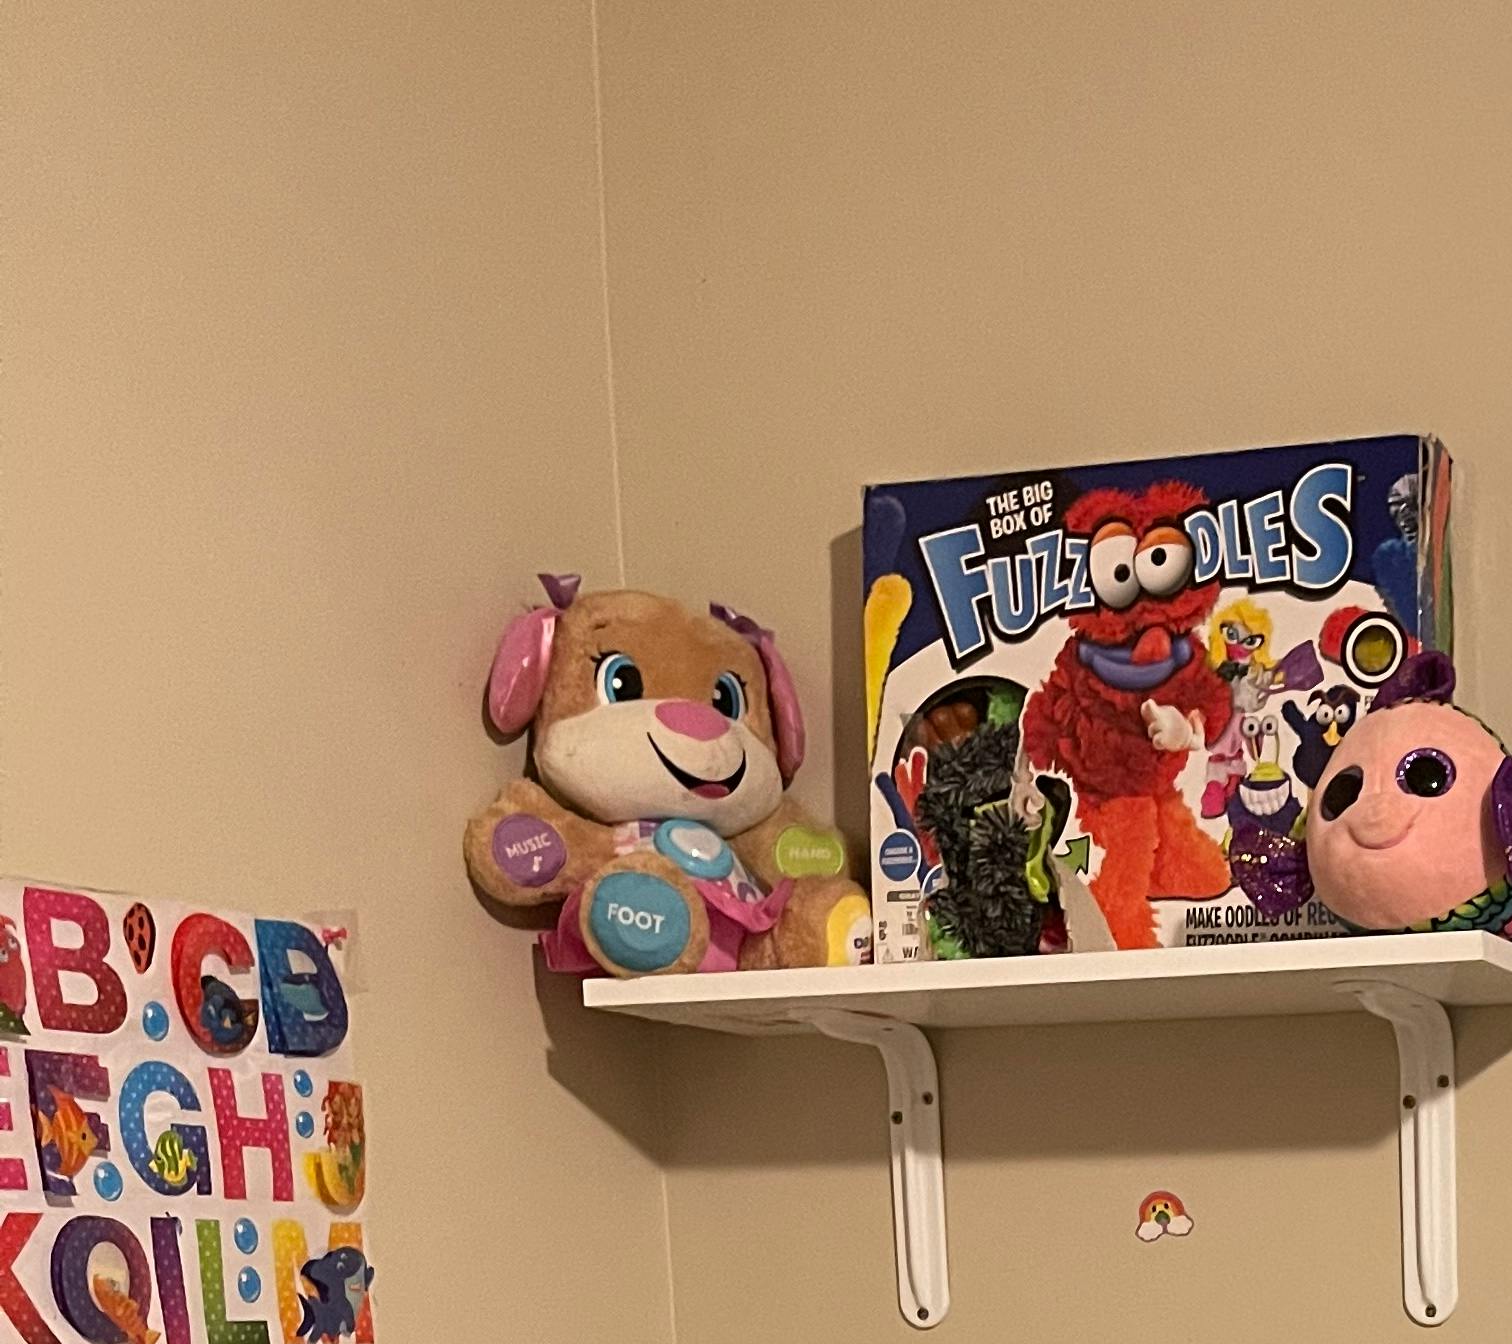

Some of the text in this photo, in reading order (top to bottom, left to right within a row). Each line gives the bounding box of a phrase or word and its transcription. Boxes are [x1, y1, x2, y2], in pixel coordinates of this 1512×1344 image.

[985, 480, 1054, 516] THE BIG
[990, 502, 1053, 539] BOX OF
[505, 832, 552, 859] MUSIC
[607, 902, 666, 934] FOOT
[1186, 905, 1222, 929] MAKE
